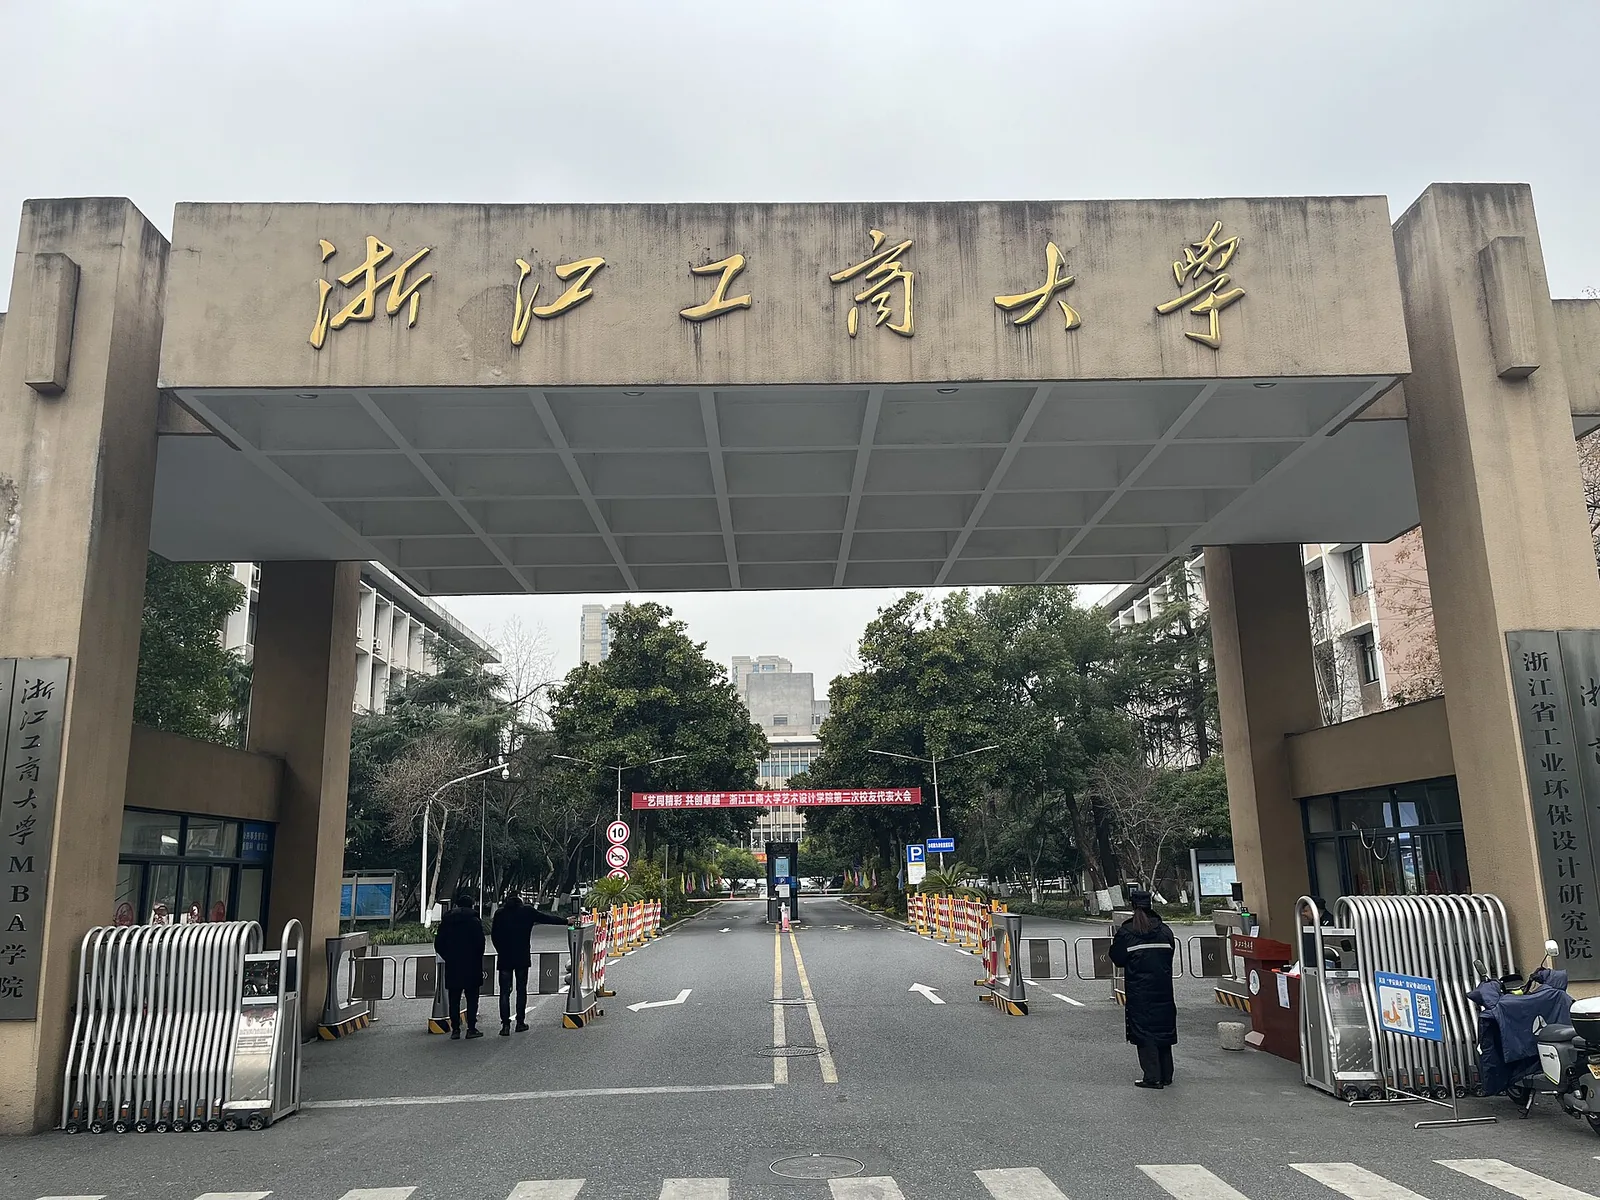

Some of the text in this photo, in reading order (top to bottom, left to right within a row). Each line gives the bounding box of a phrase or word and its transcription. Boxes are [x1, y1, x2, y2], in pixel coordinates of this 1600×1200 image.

[1523, 651, 1593, 960] 浙江省工业环保设计研究院
[612, 827, 624, 838] 10
[910, 846, 922, 861] P
